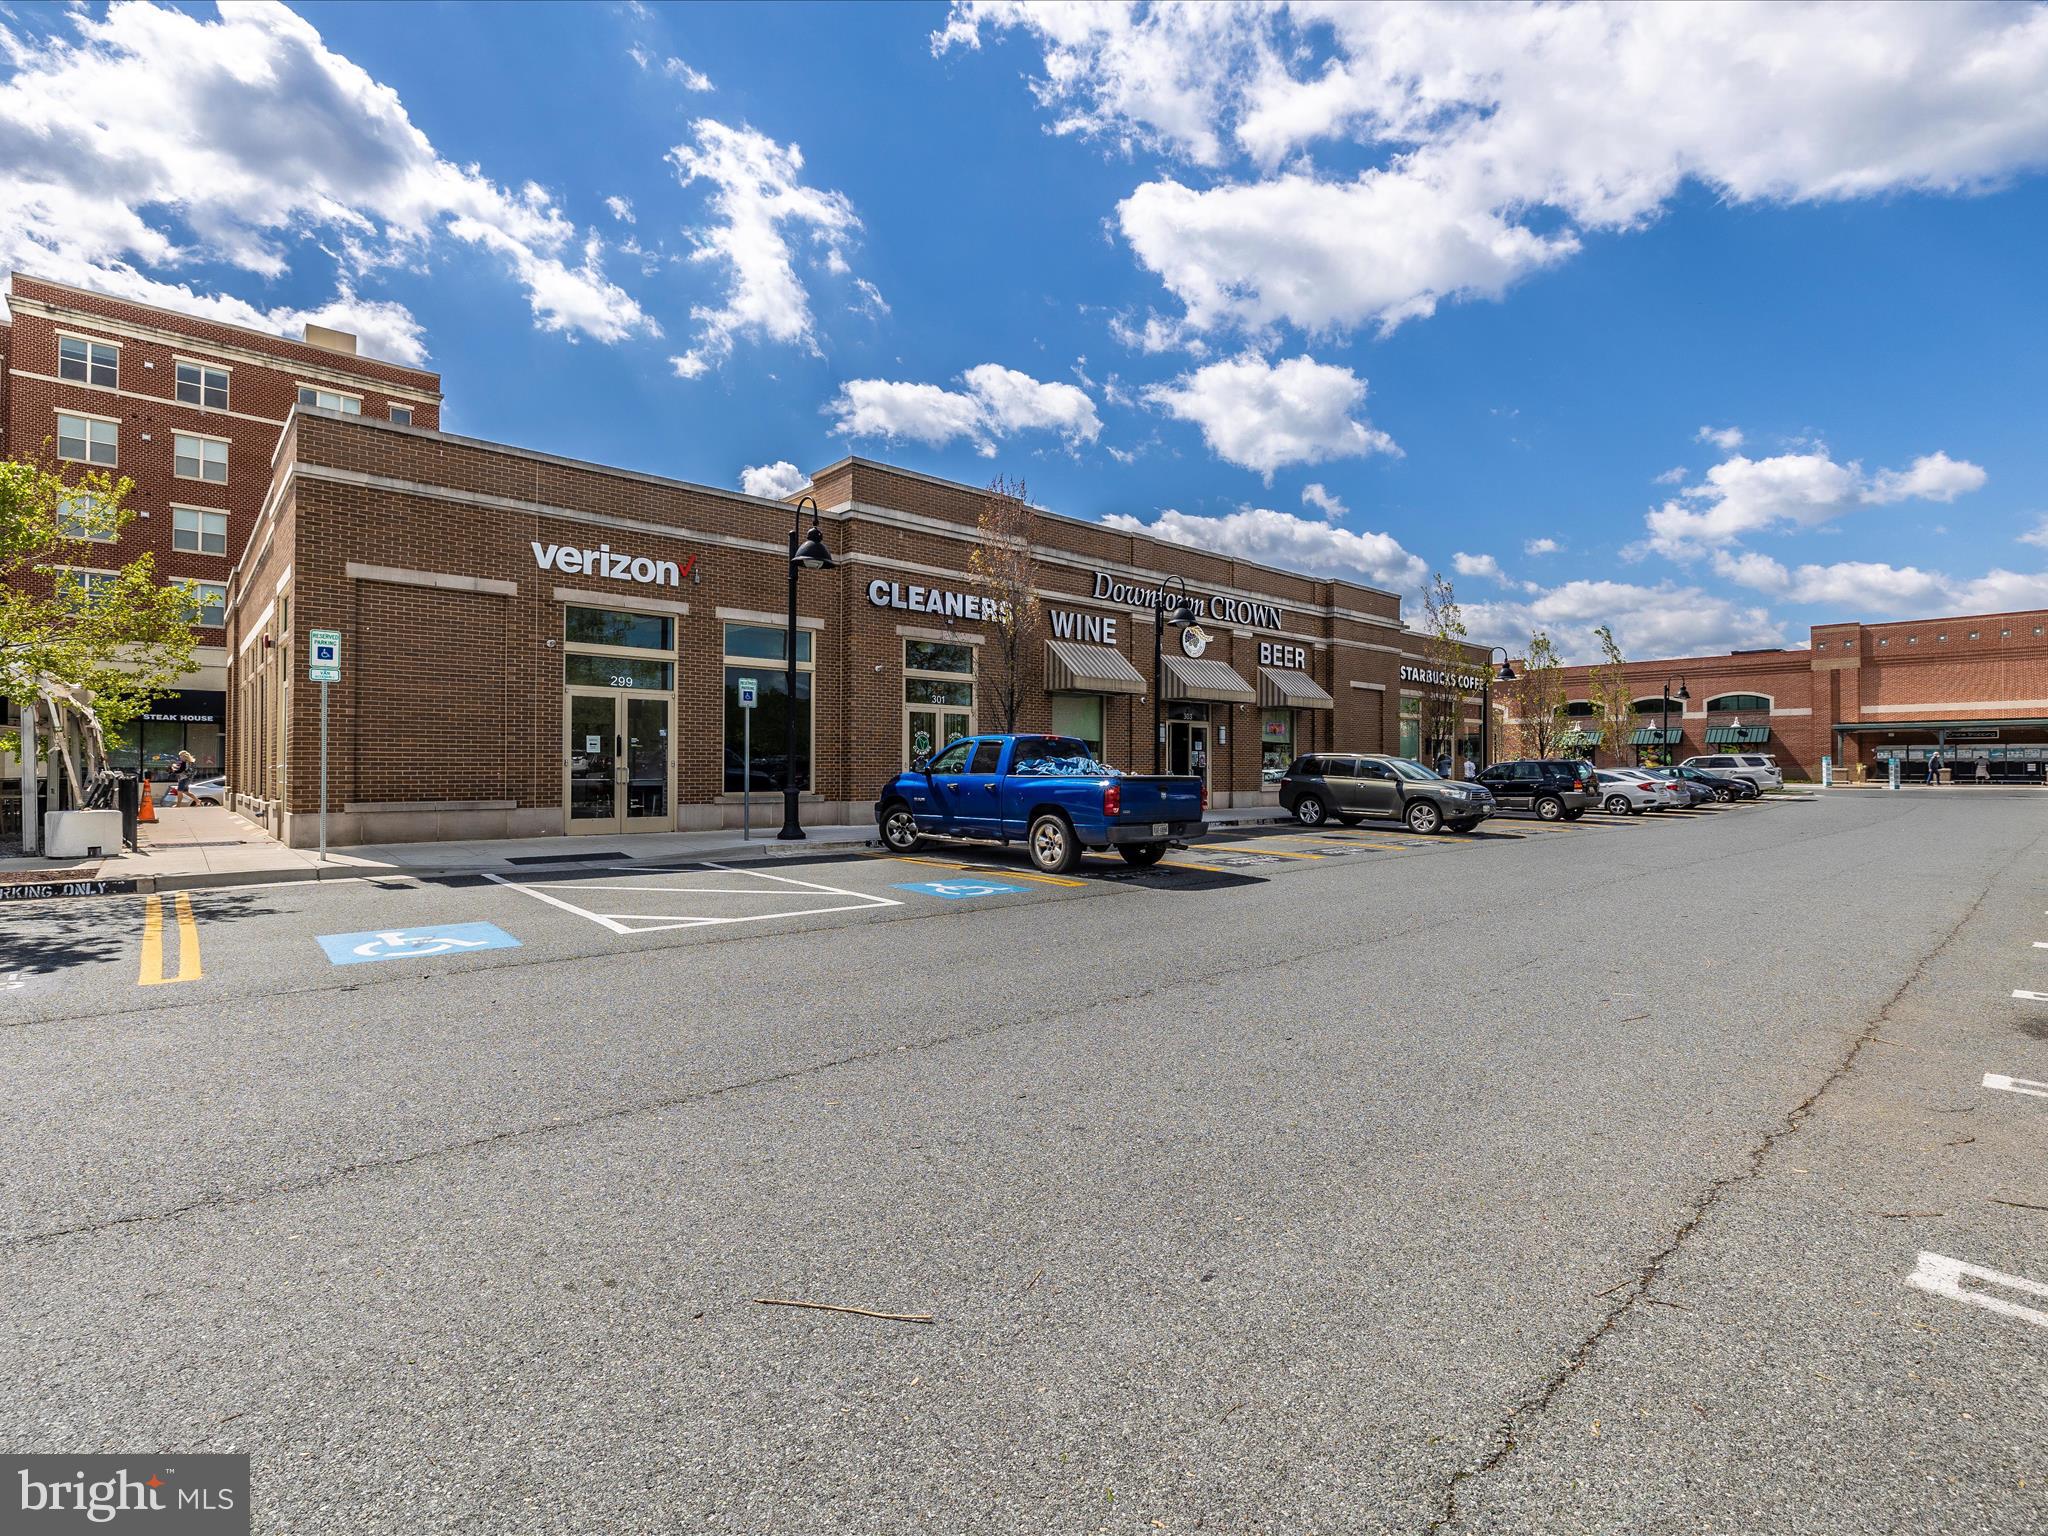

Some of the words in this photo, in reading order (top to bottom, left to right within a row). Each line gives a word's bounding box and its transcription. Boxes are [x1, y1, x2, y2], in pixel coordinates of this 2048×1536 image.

[531, 542, 679, 587] verizon
[868, 579, 1013, 624] CLEANERS
[1092, 571, 1205, 616] Downtown
[1210, 596, 1282, 630] CROWN
[1051, 609, 1117, 645] WINE
[1260, 642, 1305, 669] BEER
[610, 675, 633, 688] 299
[1400, 665, 1457, 687] STARBUCKS
[1457, 675, 1489, 692] COFFE
[931, 694, 945, 704] 301
[143, 713, 177, 721] STEAK
[62, 882, 106, 896] ONLY
